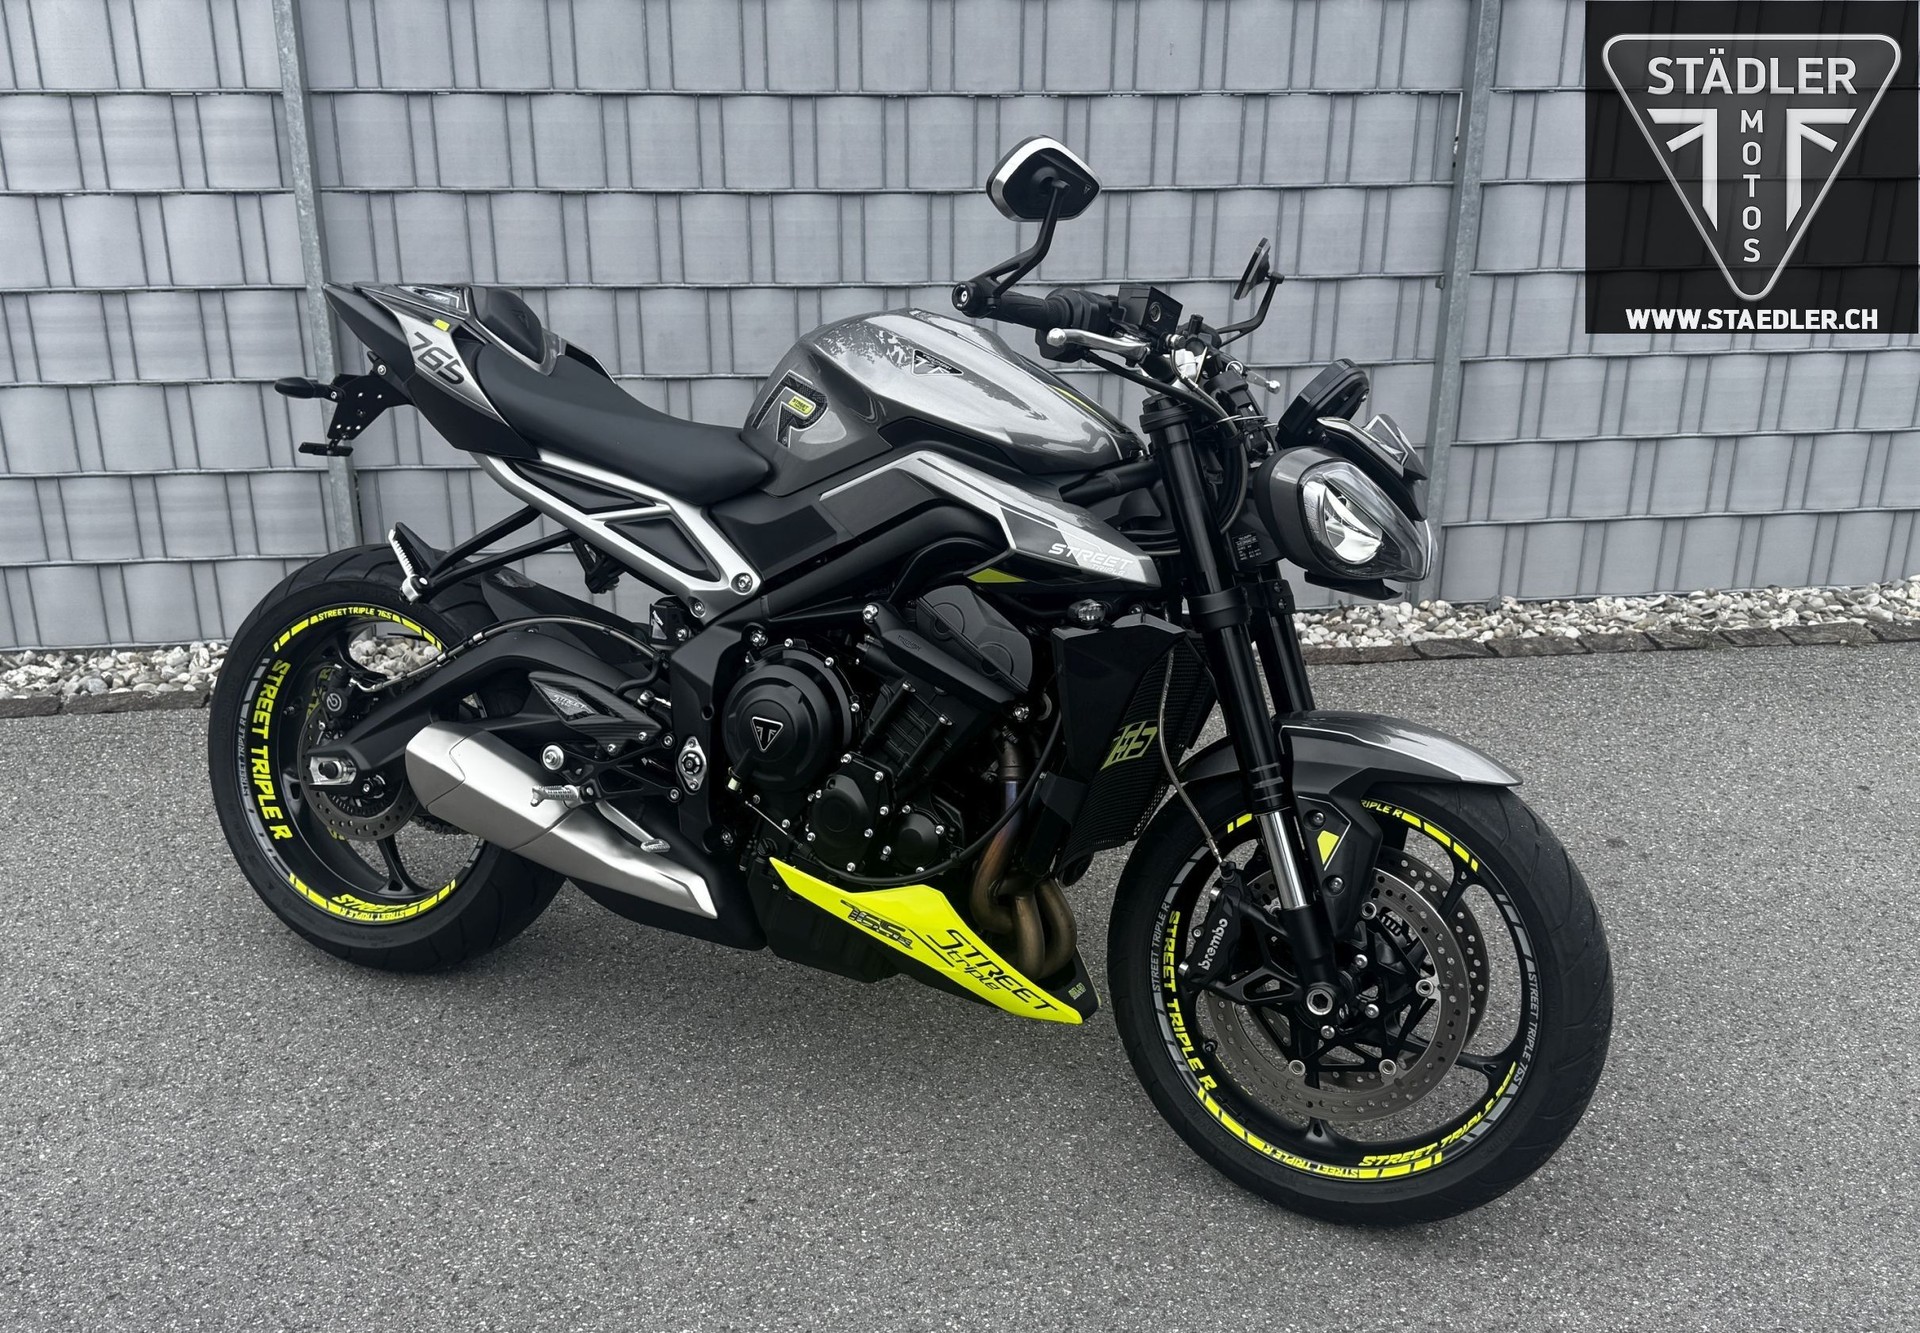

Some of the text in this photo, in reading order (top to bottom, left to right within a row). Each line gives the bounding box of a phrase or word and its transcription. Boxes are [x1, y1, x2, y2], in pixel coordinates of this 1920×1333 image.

[412, 331, 465, 384] 765
[1048, 542, 1133, 570] STREET
[318, 607, 393, 620] STREET TRIPLE 765
[251, 660, 293, 840] STREET TRIPLE R
[238, 757, 249, 796] STREET
[1361, 800, 1403, 818] RIPLE R
[1150, 902, 1170, 992] STREET TRIPLE R
[1198, 918, 1228, 970] brembo
[926, 929, 1058, 1011] STREET
[946, 950, 1001, 990] triple
[1162, 910, 1218, 1091] STREET TRIPLE R
[1513, 972, 1539, 1086] STREET TRIPLE 765
[1263, 1144, 1358, 1178] STREET TRIPLE R
[1358, 1142, 1438, 1167] STREET
